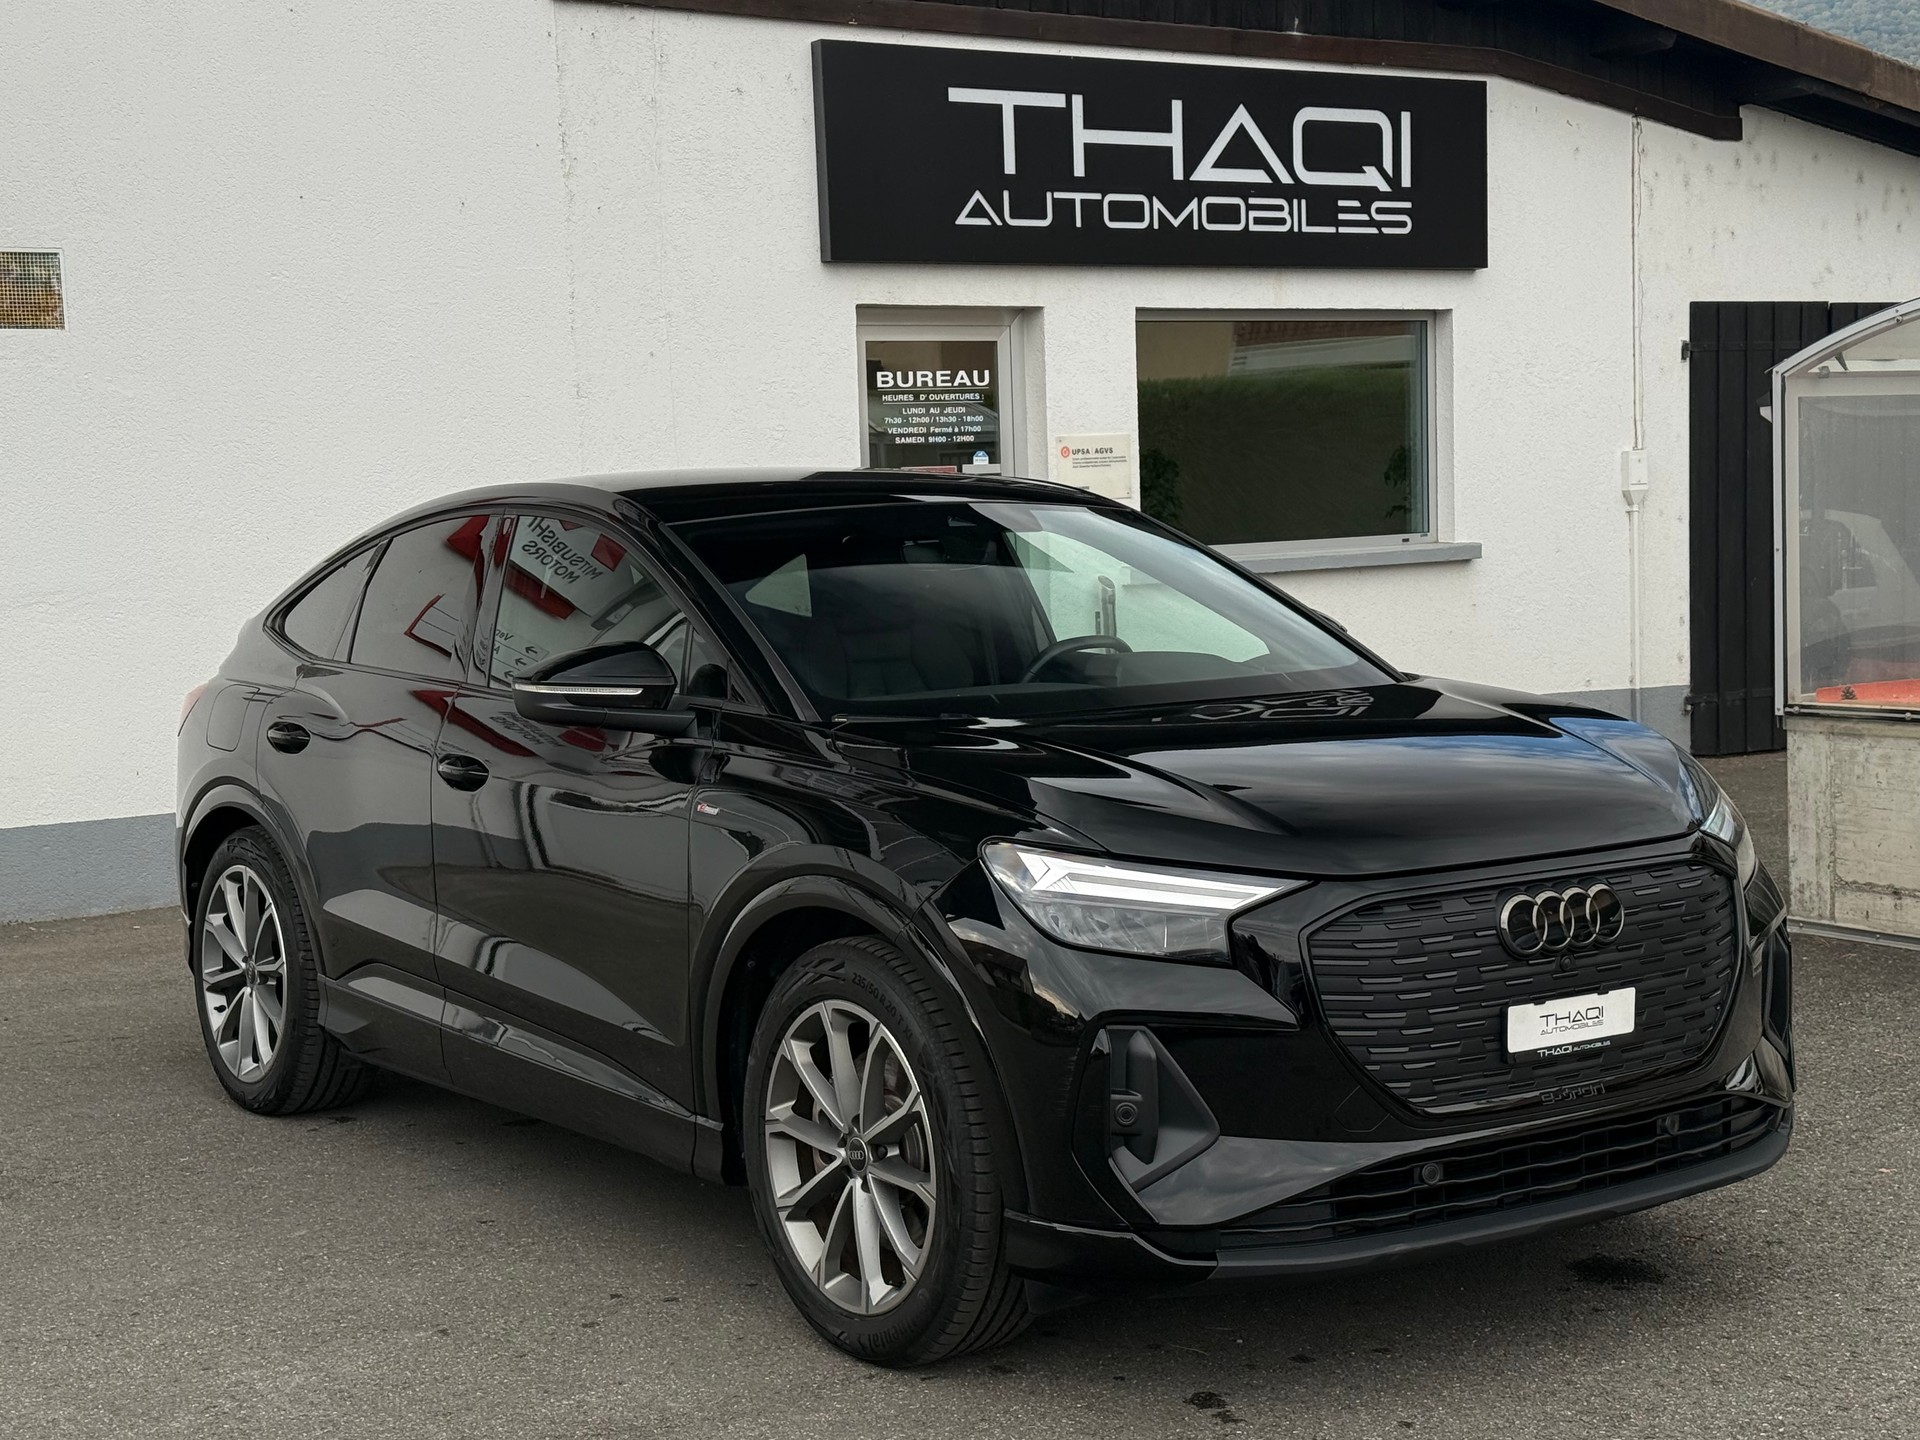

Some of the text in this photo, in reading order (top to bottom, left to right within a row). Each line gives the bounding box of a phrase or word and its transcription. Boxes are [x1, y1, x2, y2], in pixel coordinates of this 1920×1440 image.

[947, 87, 1412, 192] THAQI
[955, 189, 1413, 235] AUTOMOBILES
[876, 369, 990, 388] BUREAU
[882, 394, 914, 402] HEURES
[902, 407, 926, 415] LUNDI
[943, 406, 966, 414] JEUDI
[884, 416, 902, 424] 7h30
[908, 416, 930, 424] 12h00
[962, 415, 984, 423] 18h00
[887, 426, 927, 434] VENDREDI
[930, 425, 953, 433] Fermé
[953, 425, 958, 433] à
[895, 436, 925, 444] SAMEDI
[928, 435, 947, 443] 9H00
[1071, 448, 1090, 456] UPSA
[852, 972, 880, 999] 235/50
[1539, 1005, 1604, 1027] THAQI
[1540, 1019, 1604, 1036] AUTOMOBILES
[1536, 1045, 1572, 1058] THAQI
